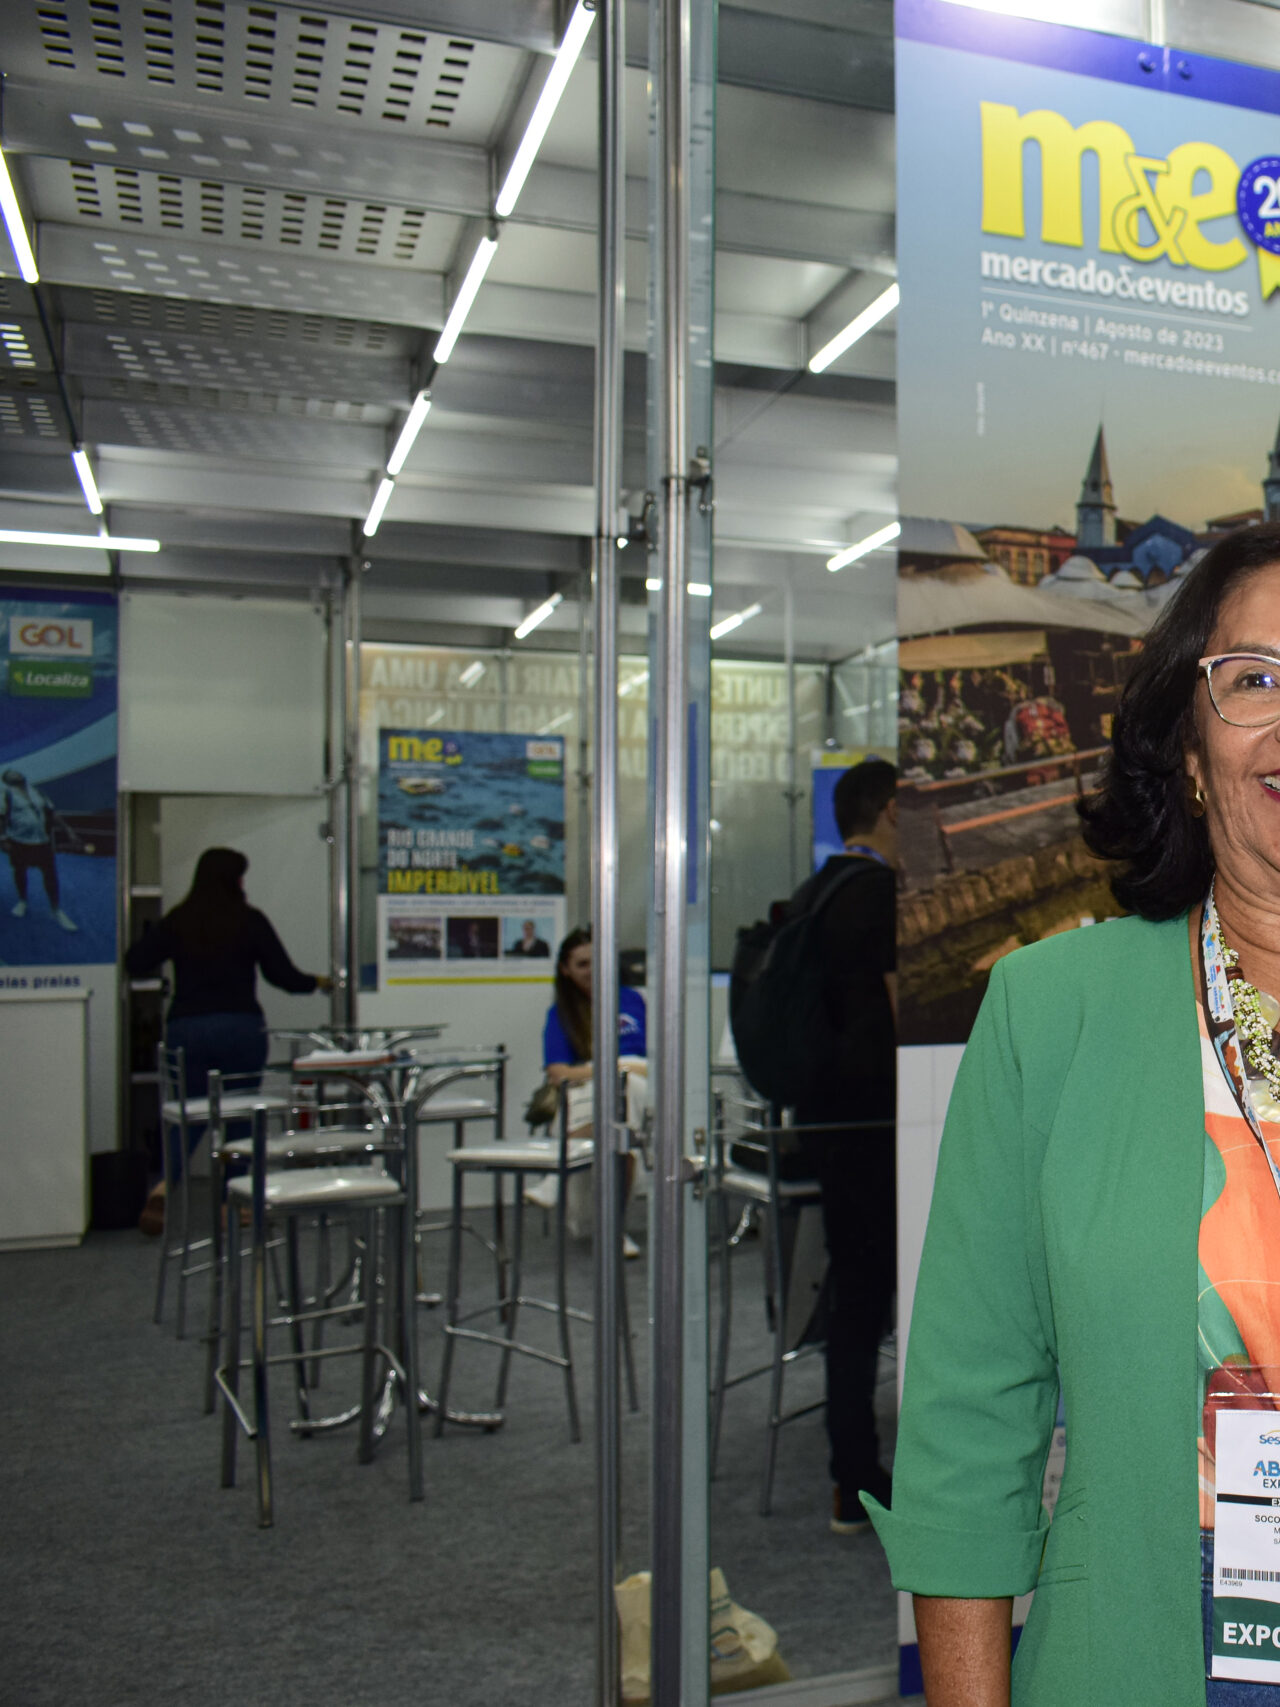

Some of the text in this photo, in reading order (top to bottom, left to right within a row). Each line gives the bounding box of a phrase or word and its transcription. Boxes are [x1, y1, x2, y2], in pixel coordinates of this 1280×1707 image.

[980, 101, 1249, 271] m&e
[981, 251, 1249, 316] mercado&eventos
[981, 326, 1017, 349] Ano
[1020, 332, 1046, 353] XX
[999, 303, 1079, 331] Quinzena
[1094, 316, 1152, 342] Agosto
[1157, 325, 1178, 346] de
[1182, 330, 1224, 352] 2023
[20, 623, 83, 649] GOL
[26, 669, 89, 688] Localiza
[33, 973, 80, 990] praias
